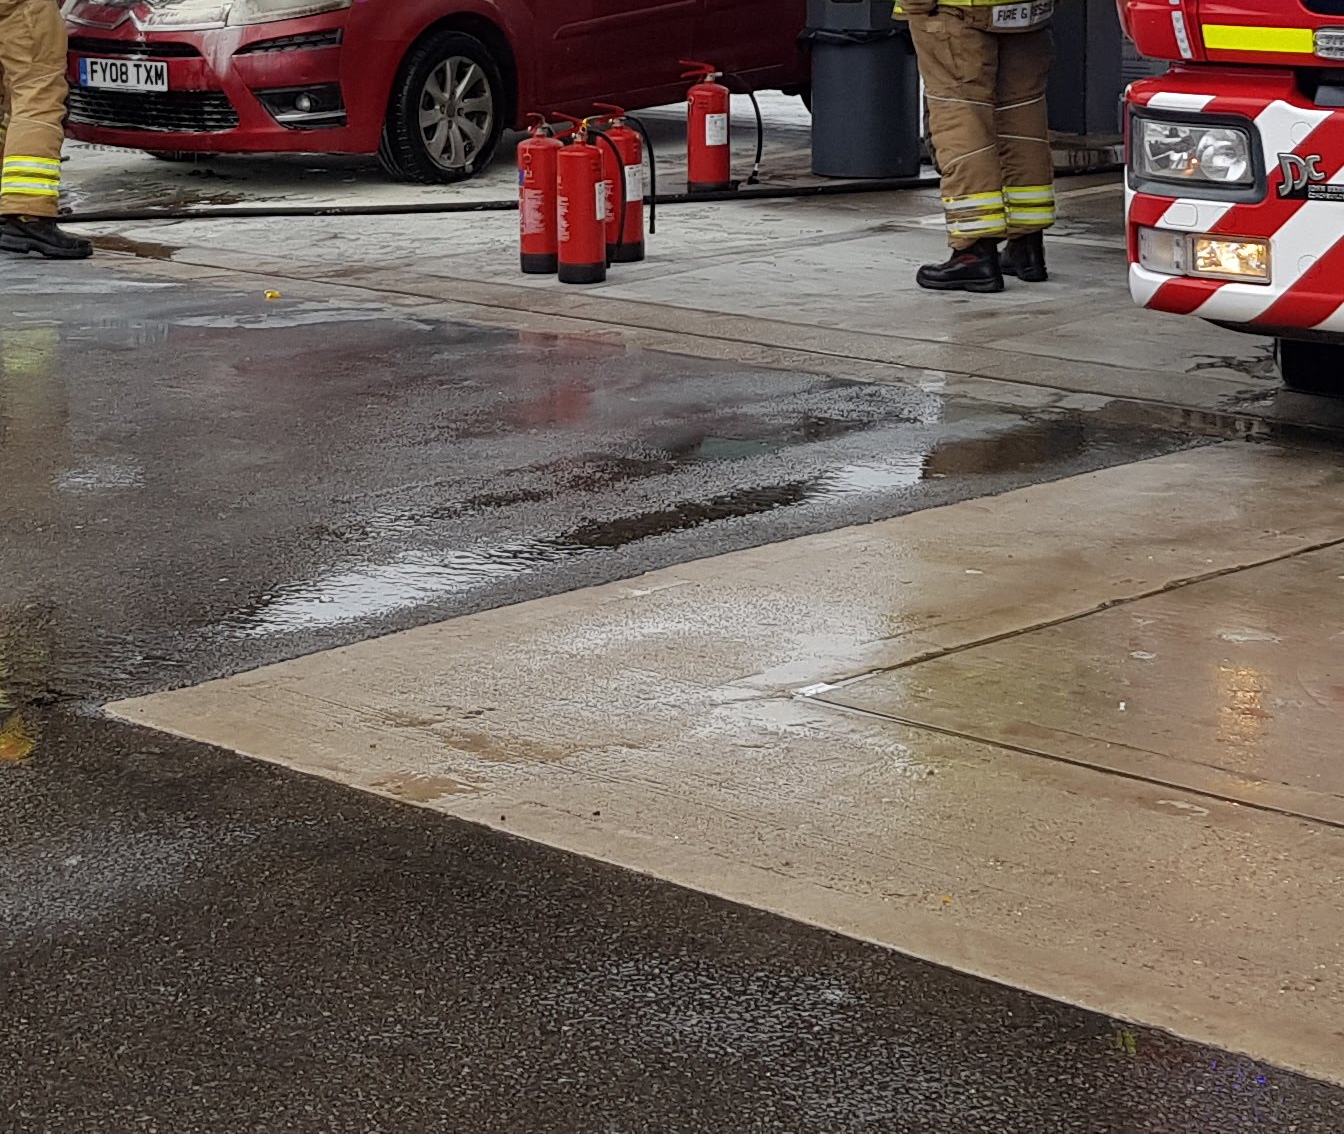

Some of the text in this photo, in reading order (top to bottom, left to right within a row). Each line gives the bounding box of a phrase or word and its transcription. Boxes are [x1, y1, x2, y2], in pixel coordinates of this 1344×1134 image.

[997, 8, 1017, 22] FIRE
[90, 61, 165, 86] FY08 TXM
